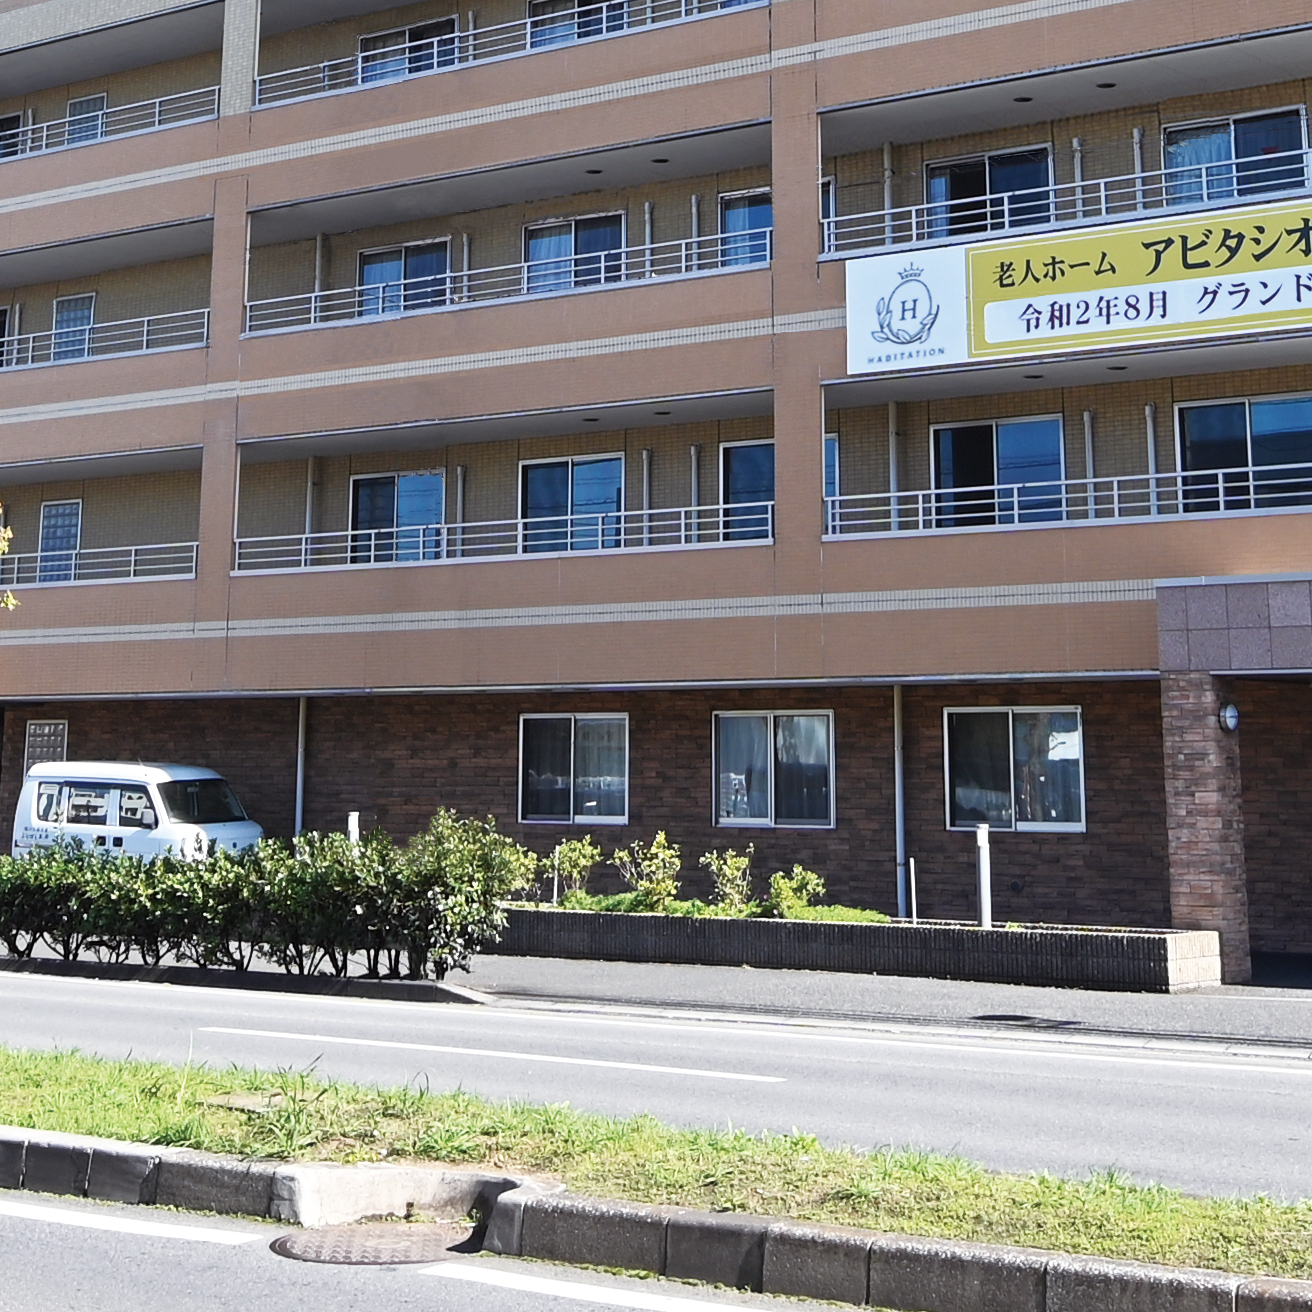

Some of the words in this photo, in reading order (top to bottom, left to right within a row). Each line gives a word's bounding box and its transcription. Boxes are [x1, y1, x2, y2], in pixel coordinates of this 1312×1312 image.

[992, 251, 1117, 289] 老人ホーム
[899, 298, 919, 322] H
[1018, 290, 1168, 334] 令和2年8月
